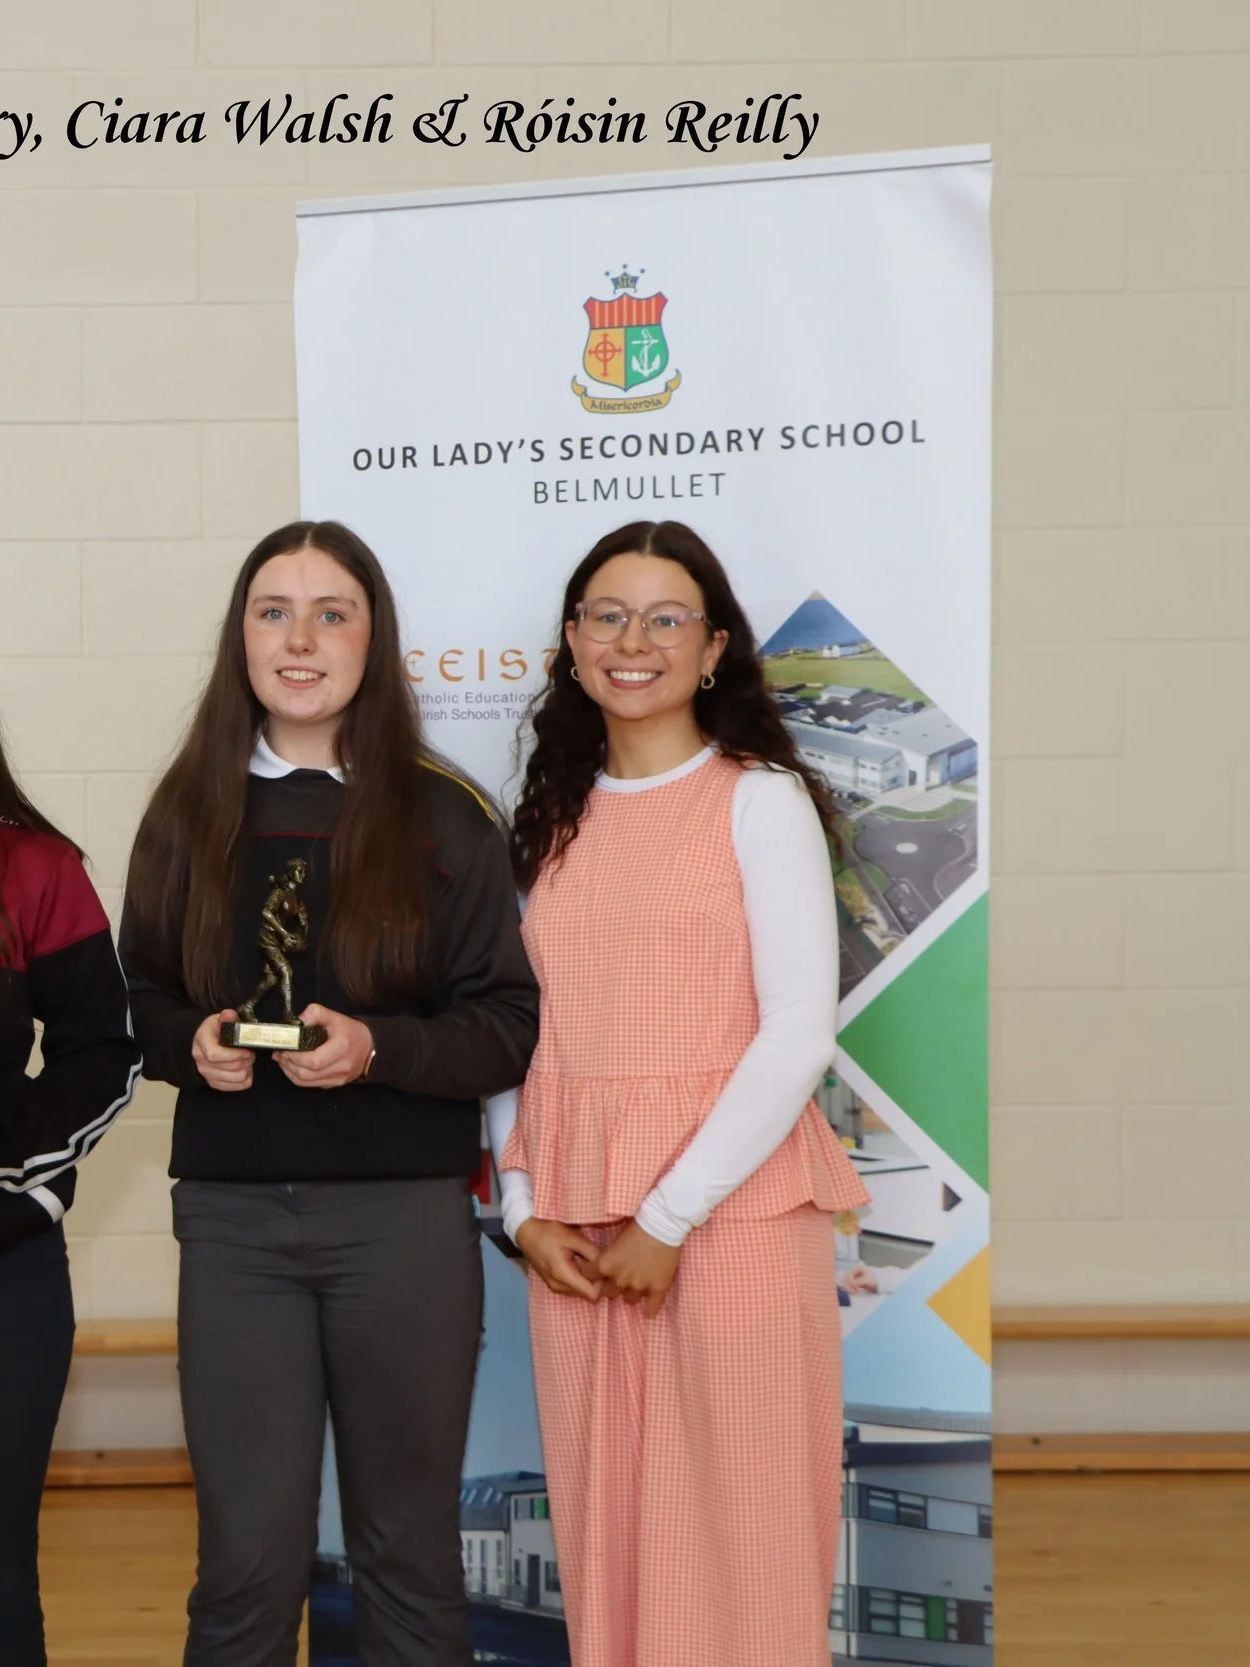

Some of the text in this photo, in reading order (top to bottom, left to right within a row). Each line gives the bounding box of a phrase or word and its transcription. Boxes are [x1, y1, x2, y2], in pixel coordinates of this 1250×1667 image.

[590, 398, 664, 412] Misericordia
[353, 419, 925, 472] OUR LADY'S SECONDARY SCHOOL
[533, 472, 726, 505] BELMULLET
[465, 691, 535, 705] Education
[451, 708, 501, 721] Schools
